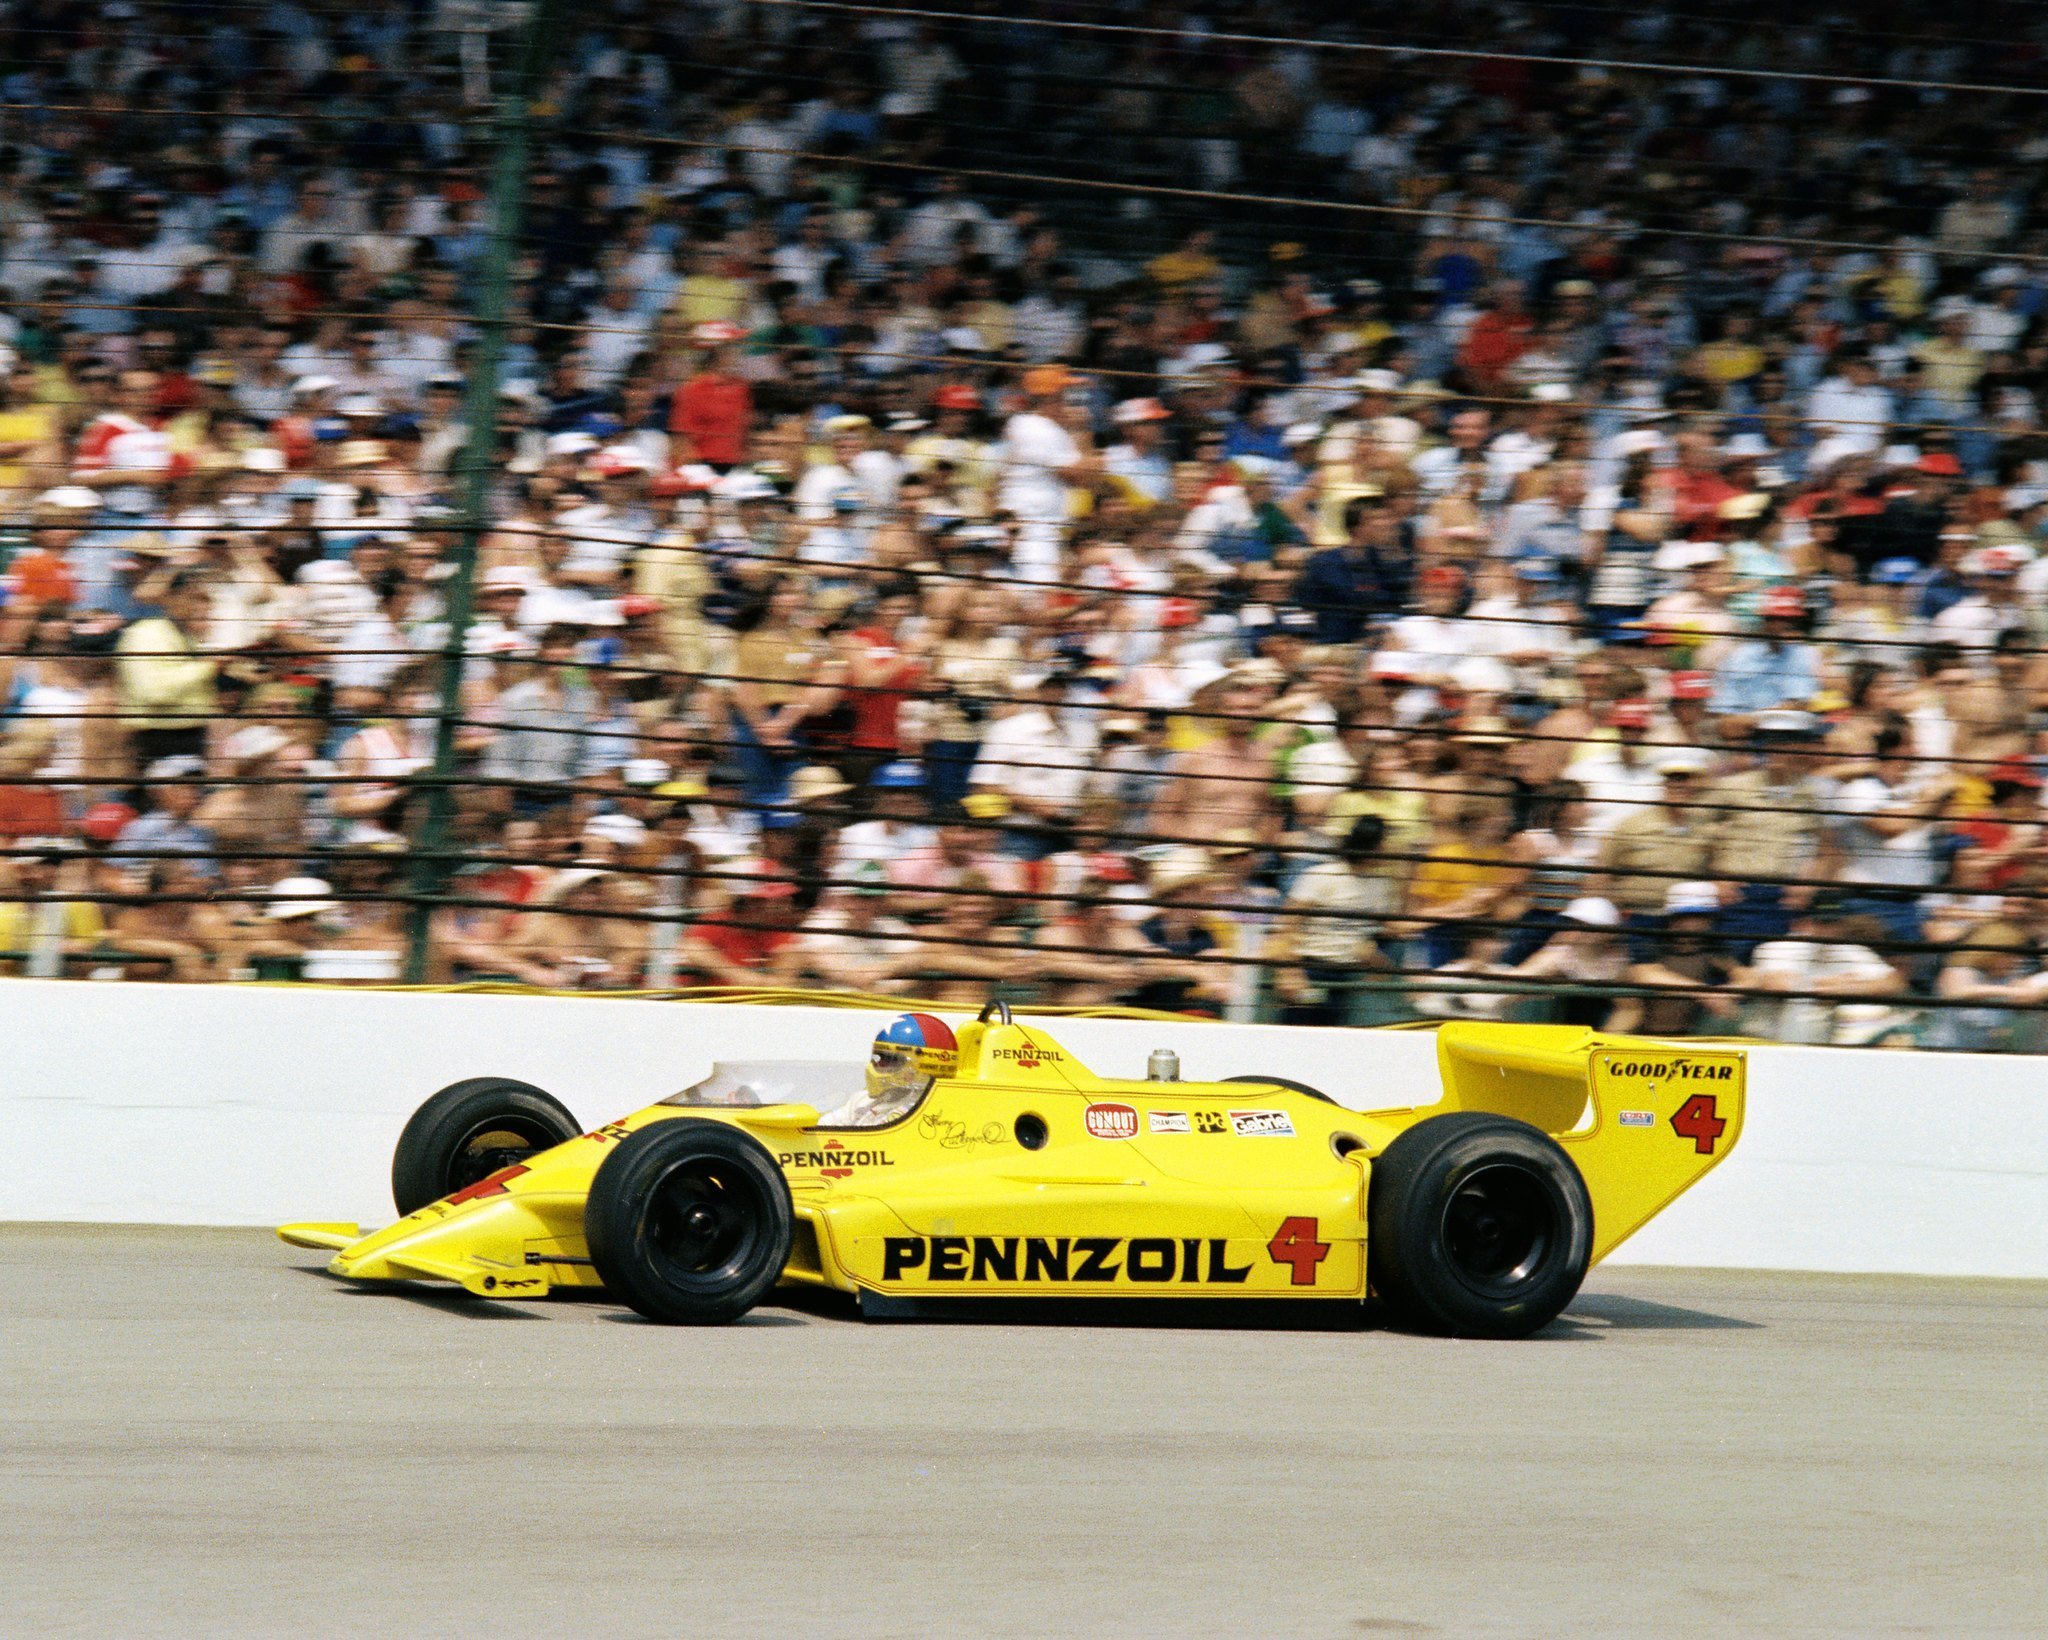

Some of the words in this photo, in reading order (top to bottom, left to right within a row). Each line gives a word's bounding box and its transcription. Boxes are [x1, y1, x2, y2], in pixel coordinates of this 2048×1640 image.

[992, 1048, 1064, 1062] PENNZOIL
[1087, 1110, 1135, 1130] GUMOUT
[1151, 1118, 1186, 1126] CHAMPION
[1668, 1093, 1727, 1155] 4
[778, 1150, 895, 1168] PENNZOIL
[881, 1237, 1255, 1282] PENNZOIL
[1266, 1216, 1332, 1286] 4
